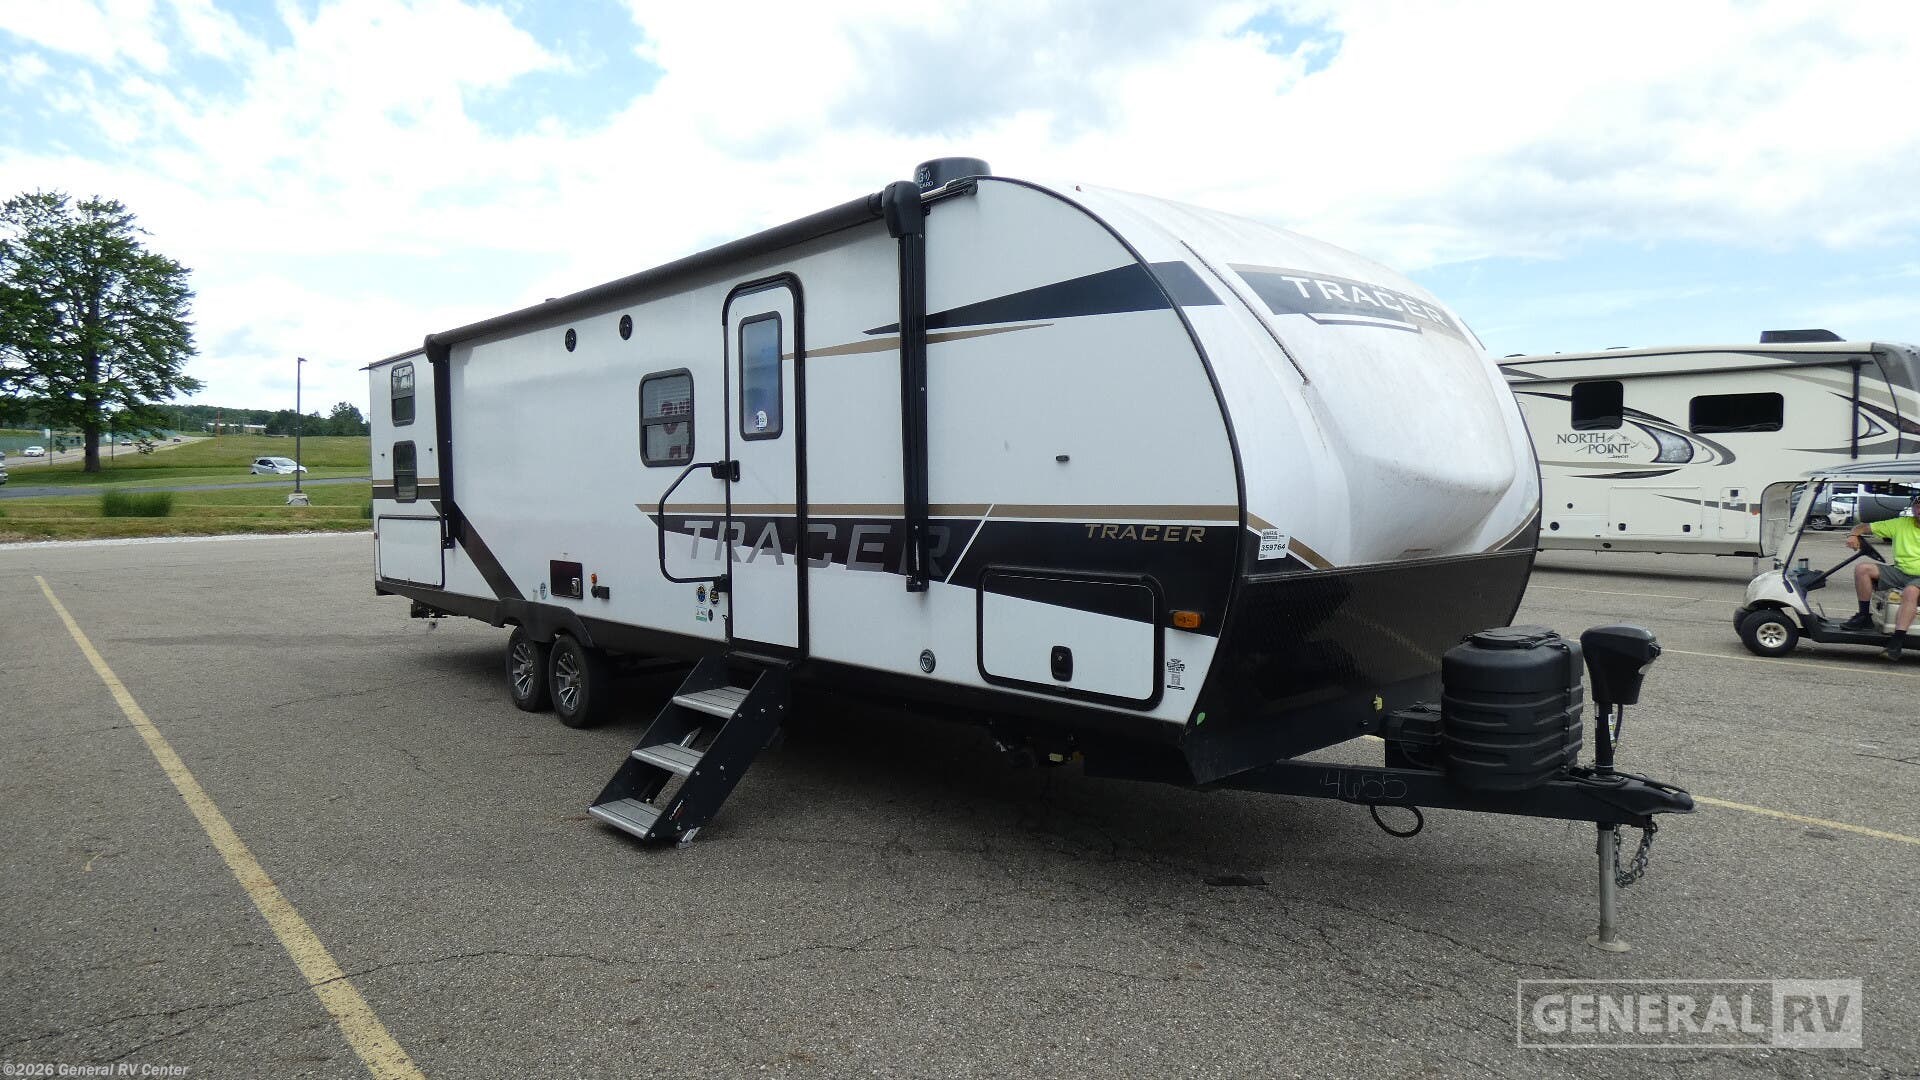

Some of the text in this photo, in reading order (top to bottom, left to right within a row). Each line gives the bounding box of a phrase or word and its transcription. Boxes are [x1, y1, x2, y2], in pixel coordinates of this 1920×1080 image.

[1281, 275, 1449, 328] TRACER
[1556, 433, 1606, 444] NORTH
[1588, 443, 1631, 454] POINT
[1085, 523, 1207, 543] TRACER
[1260, 543, 1286, 552] 359764
